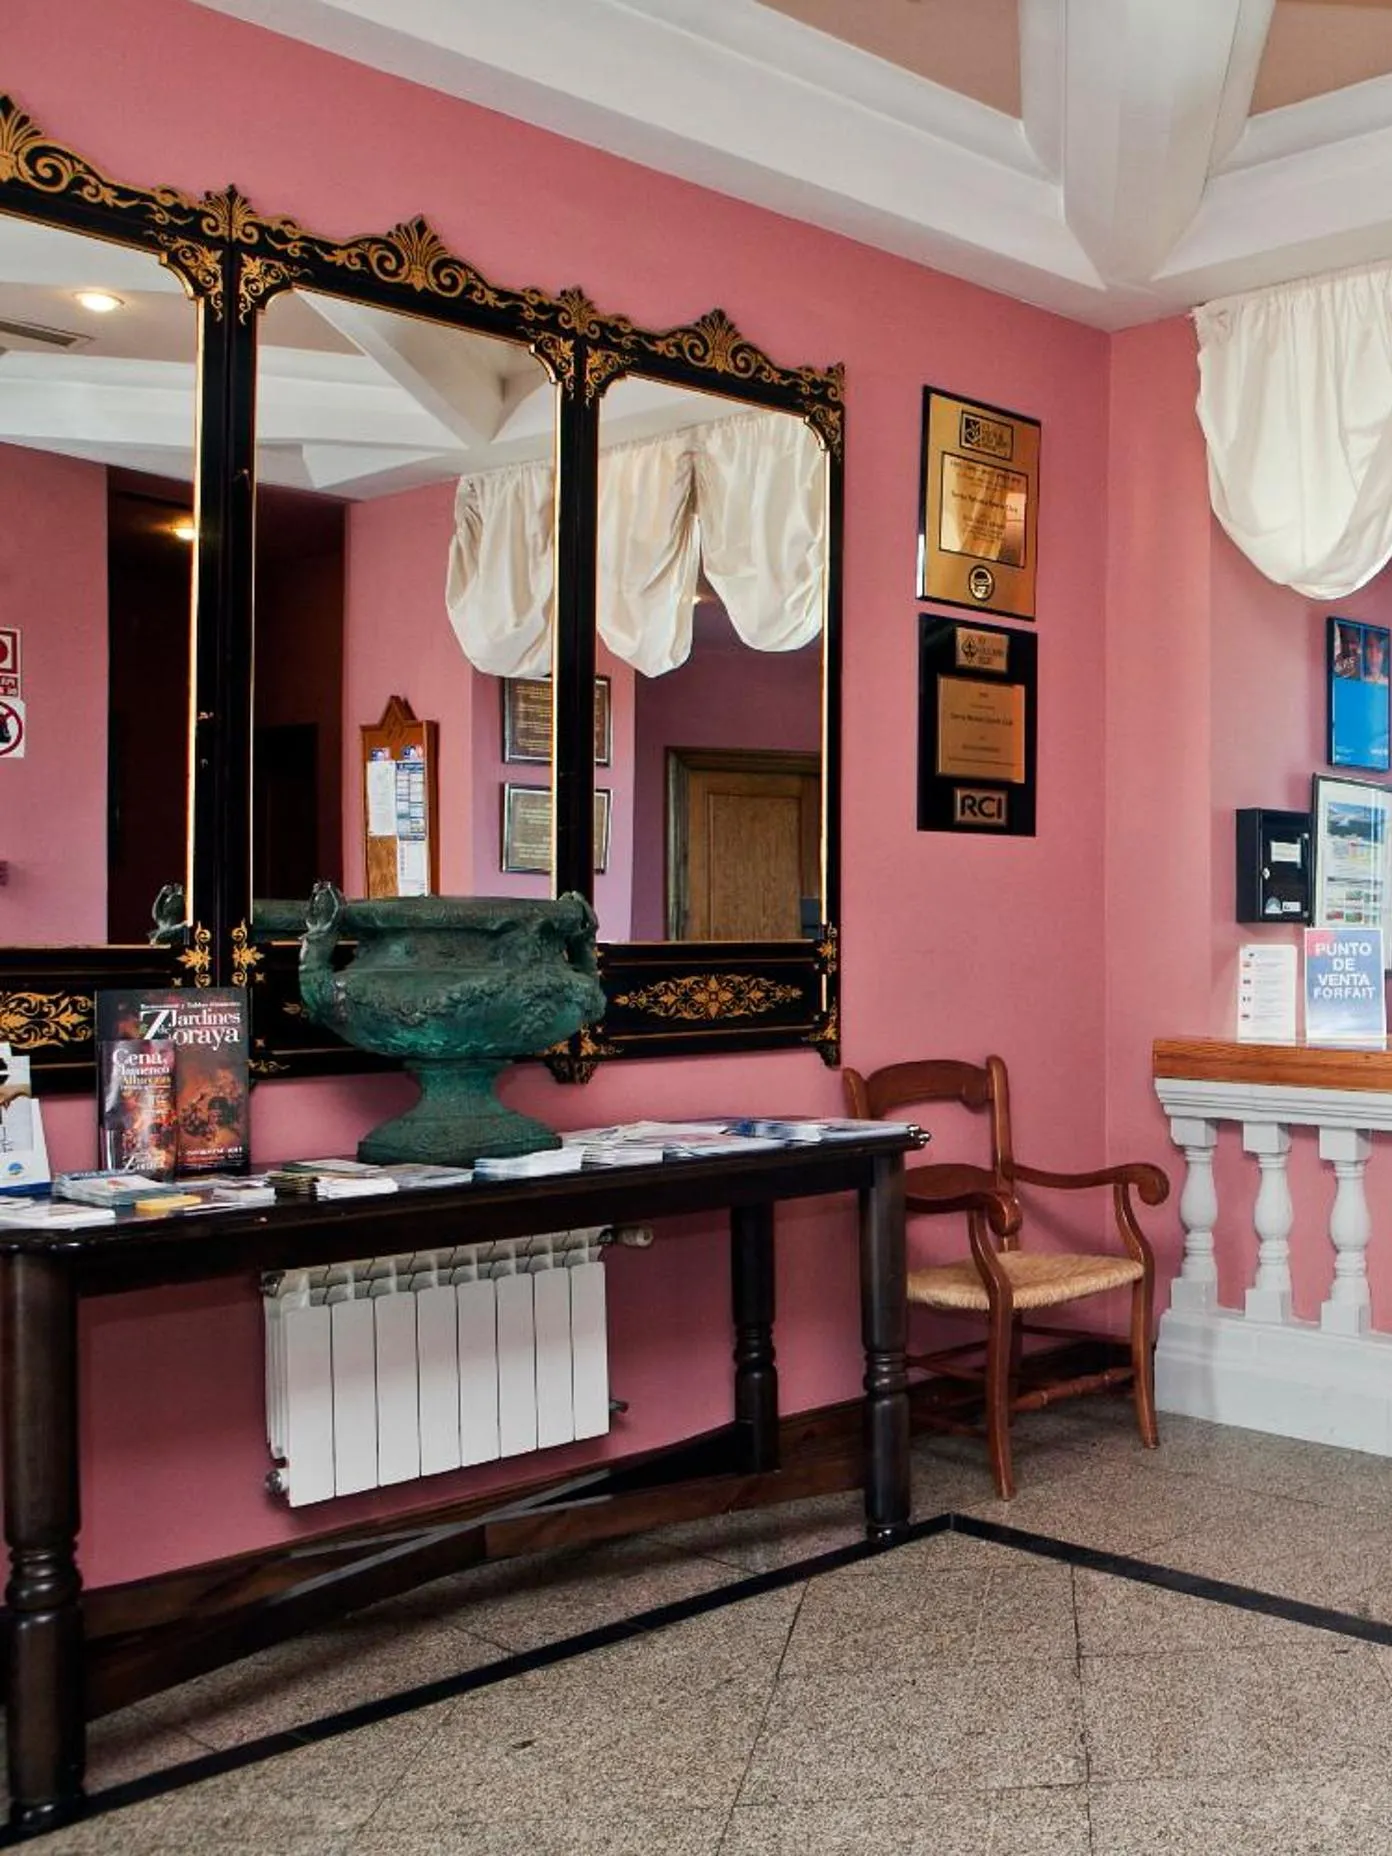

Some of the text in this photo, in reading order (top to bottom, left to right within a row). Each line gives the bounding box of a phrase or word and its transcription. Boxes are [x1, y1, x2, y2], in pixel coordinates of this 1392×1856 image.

[960, 795, 1002, 819] RCI
[1315, 942, 1372, 957] PUNTO
[1333, 958, 1355, 971] DE
[1318, 973, 1370, 986] VENTA
[1314, 987, 1376, 999] FORFAIT
[168, 1007, 240, 1027] Jardines
